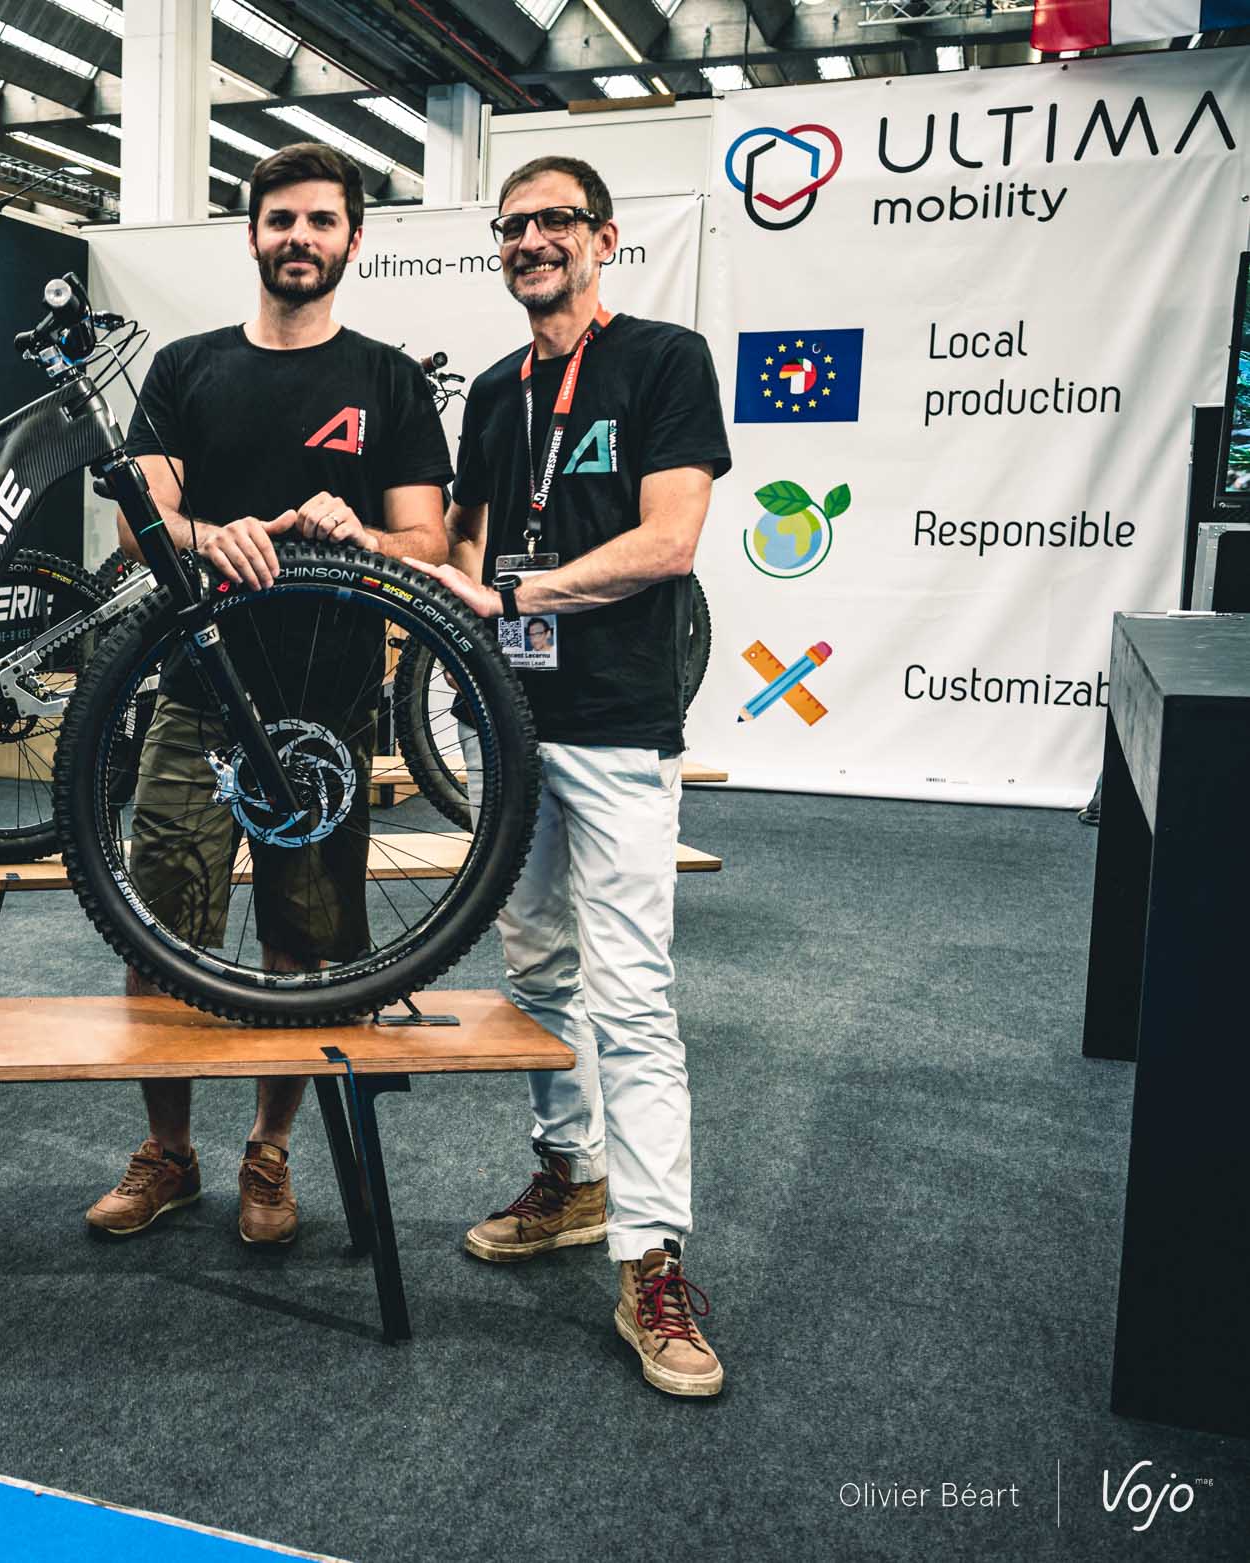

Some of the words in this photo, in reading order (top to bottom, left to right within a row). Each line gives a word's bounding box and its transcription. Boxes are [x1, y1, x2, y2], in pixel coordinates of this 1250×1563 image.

[878, 90, 1236, 173] ULTIMA
[874, 182, 1067, 222] mobility
[929, 320, 1028, 359] Local
[925, 377, 1121, 427] production
[541, 428, 564, 494] NOTRESPHERE
[914, 510, 1136, 556] Responsible
[412, 598, 474, 653] GRIFFUS
[904, 664, 1110, 707] Customizab
